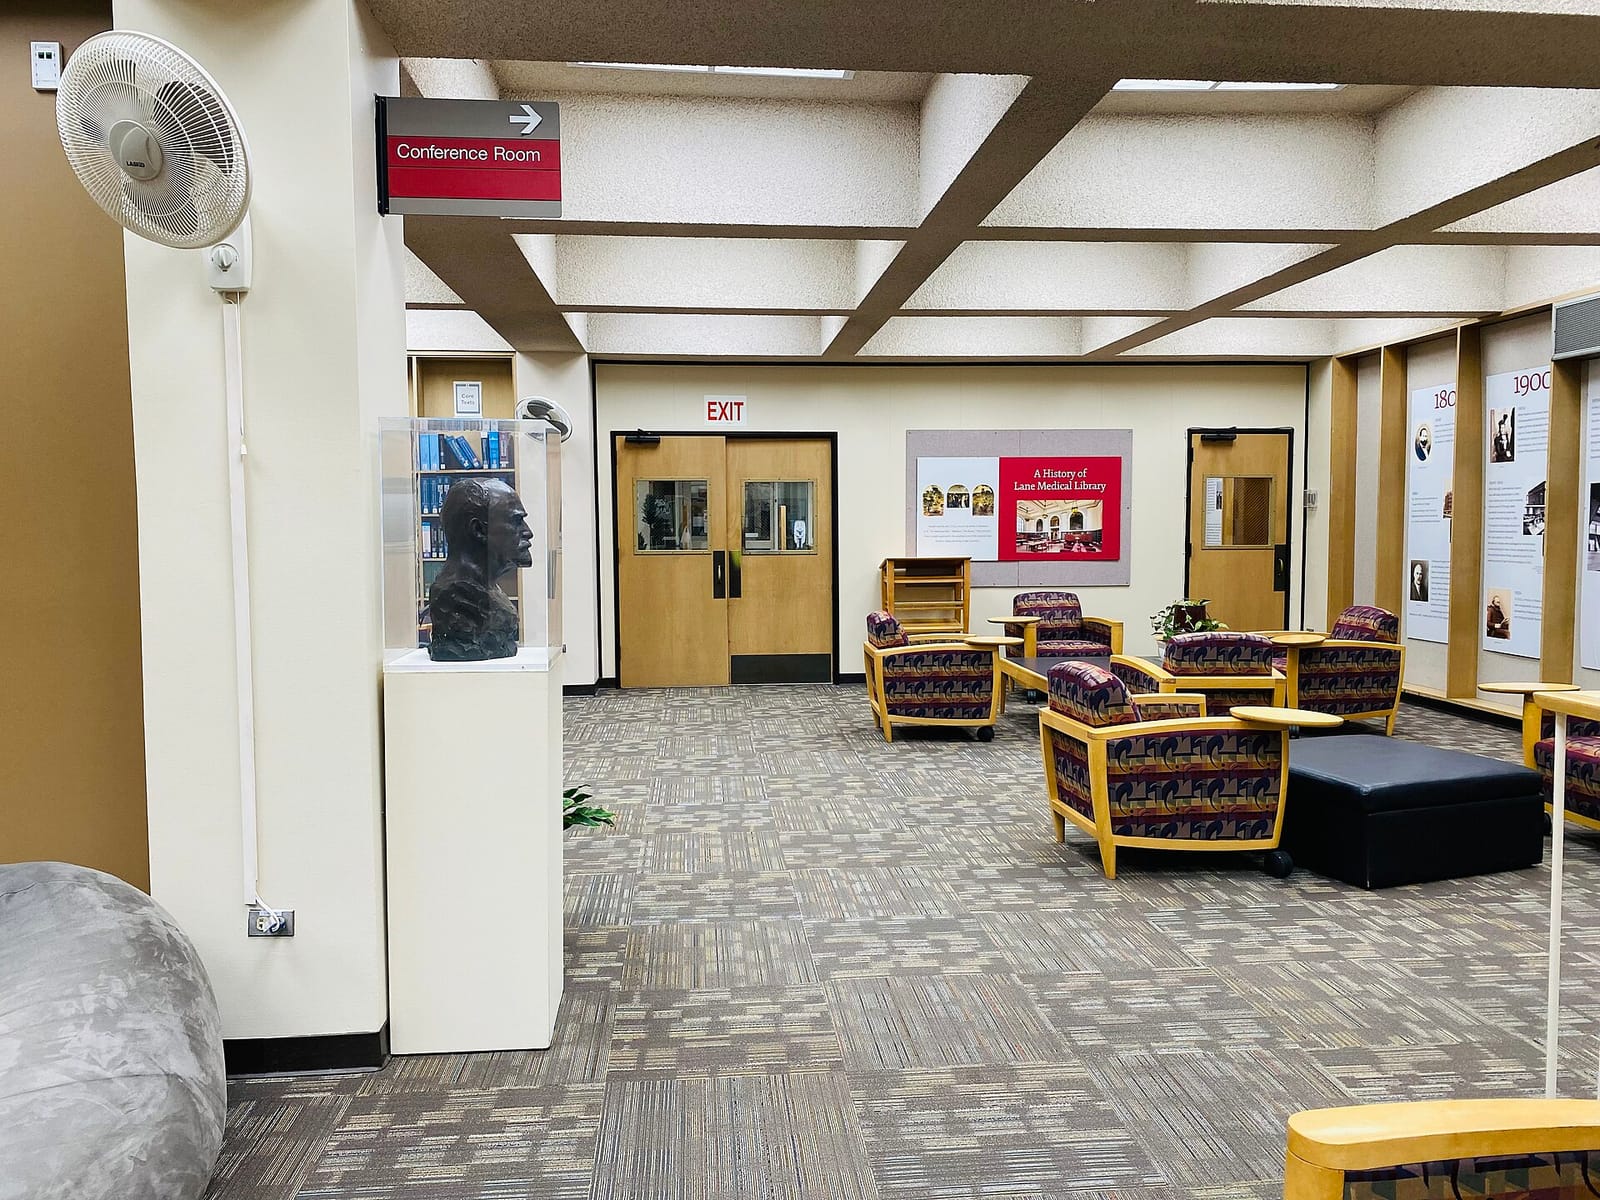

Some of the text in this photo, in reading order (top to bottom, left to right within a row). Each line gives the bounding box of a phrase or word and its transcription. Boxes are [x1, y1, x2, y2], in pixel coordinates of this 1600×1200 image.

[397, 143, 541, 162] Conference Room
[707, 401, 744, 421] EXIT
[1033, 467, 1088, 481] A History of
[1013, 479, 1107, 493] Lane Medical Library
